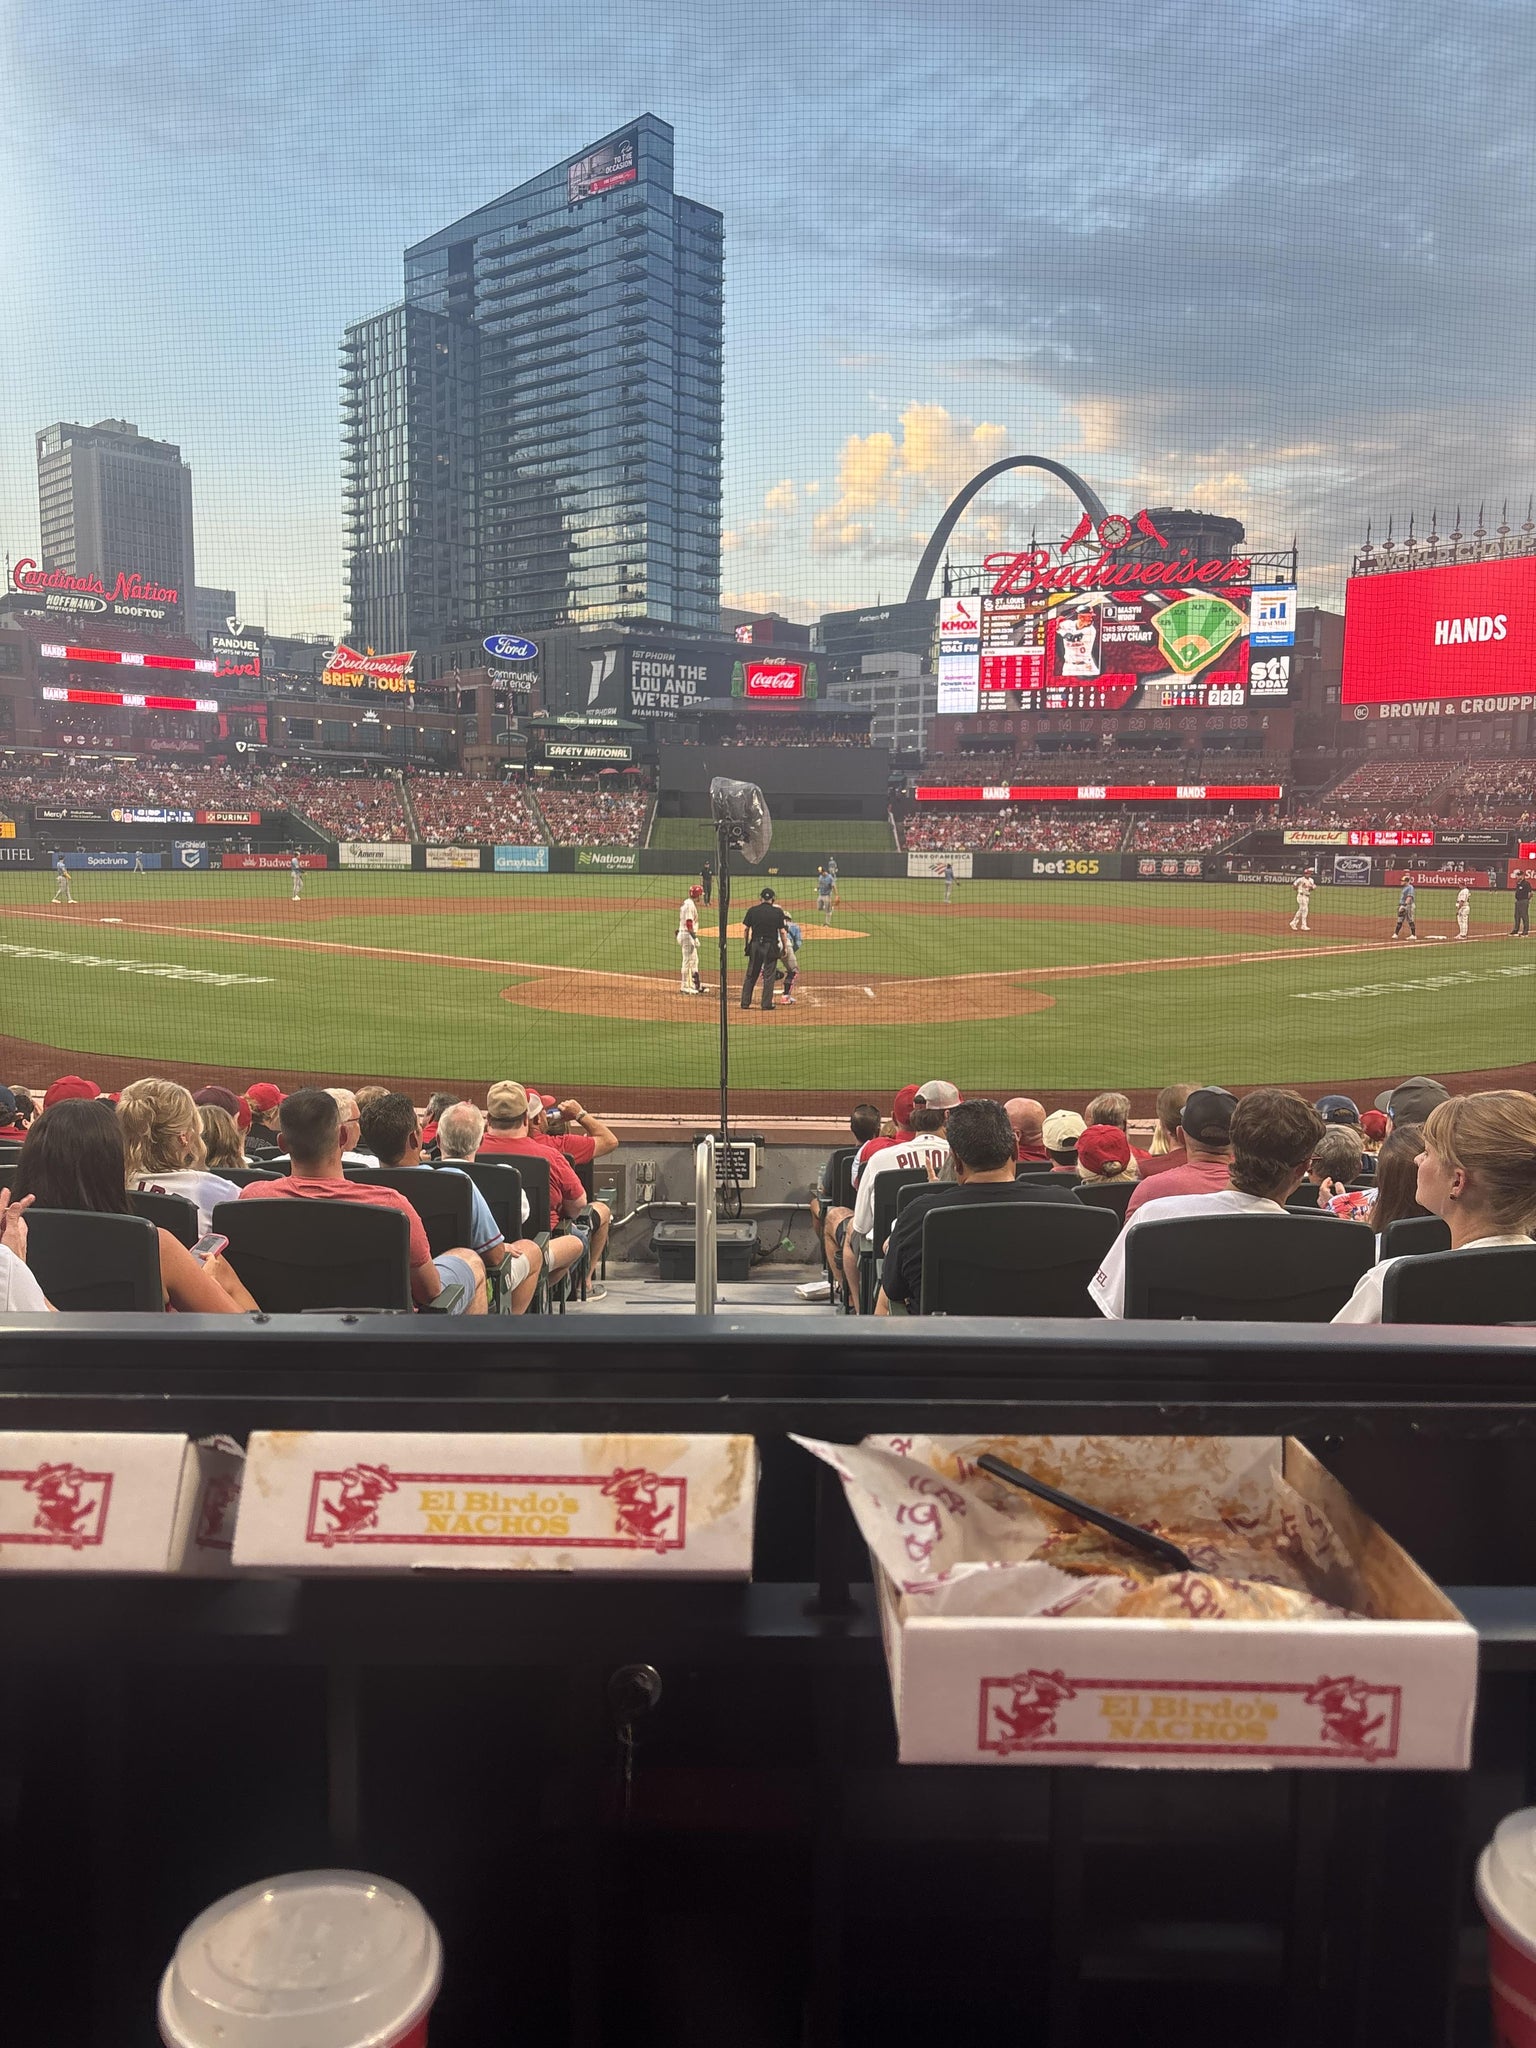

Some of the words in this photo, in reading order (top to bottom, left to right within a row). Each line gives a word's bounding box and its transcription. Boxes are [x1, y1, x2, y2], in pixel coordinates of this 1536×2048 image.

[614, 155, 621, 164] TO
[622, 152, 633, 161] THE
[605, 159, 633, 174] OCCASION
[1375, 549, 1450, 570] WORLD
[983, 549, 1250, 595] Budweiser
[13, 557, 105, 594] Cardinals
[105, 571, 178, 604] Nation
[46, 594, 97, 610] HOFFMANN
[114, 604, 166, 619] ROOFTOP
[941, 620, 978, 631] KMOX
[1117, 625, 1140, 633] SEASON
[1435, 614, 1508, 645] HANDS
[212, 637, 260, 651] FANDUEL
[1102, 633, 1130, 643] SPRAY
[1130, 631, 1153, 642] CHART
[41, 643, 67, 658] HANDS
[213, 647, 234, 656] SPORTS
[495, 637, 528, 656] Ford
[964, 643, 978, 652] FM
[121, 652, 145, 666] HANDS
[322, 651, 414, 674] Budweiser
[632, 650, 646, 659] 1ST
[645, 652, 676, 661] PHORM
[195, 659, 217, 673] HANDS
[214, 656, 261, 678] Live!
[631, 660, 675, 678] FROM
[678, 664, 707, 681] THE
[1251, 656, 1290, 680] stl
[322, 671, 365, 688] BREW
[368, 676, 416, 693] HOUSE
[488, 667, 538, 684] Community
[750, 672, 798, 689] Coca-Cola
[632, 676, 661, 692] LOU
[664, 678, 696, 695] AND
[1251, 680, 1289, 689] TODAY
[42, 686, 68, 700] HANDS
[631, 691, 680, 709] WE'RE
[122, 694, 146, 707] HANDS
[1379, 701, 1440, 719] BROWN
[1444, 703, 1456, 715] &
[1037, 719, 1050, 733] 10
[1058, 719, 1072, 732] 14
[1079, 718, 1094, 732] 17
[1128, 717, 1146, 731] 23
[1153, 717, 1171, 731] 24
[1179, 716, 1198, 730] 42
[1205, 716, 1224, 730] 45
[549, 746, 583, 757] SAFETY
[583, 747, 628, 759] NATIONAL
[982, 787, 1010, 800] HANDS
[1077, 786, 1107, 799] HANDS
[1176, 786, 1207, 799] HANDS
[43, 809, 63, 819] Mercy
[216, 813, 249, 821] PURINA
[1288, 830, 1343, 840] Schnucks
[1441, 835, 1460, 844] Mercy
[174, 841, 206, 849] CarShield
[87, 856, 125, 866] Spectrum
[357, 850, 385, 858] Ameren
[592, 853, 635, 864] National
[496, 857, 545, 868] Graybar
[1032, 858, 1100, 875] bet365
[1142, 865, 1153, 873] 66
[1163, 865, 1176, 873] 66
[1186, 865, 1198, 873] 66
[1341, 859, 1364, 871] Ford
[1237, 874, 1262, 883] BUSCH
[1263, 874, 1296, 883] STADIUM
[1417, 873, 1475, 885] Budweiser
[419, 1490, 455, 1513] El
[463, 1491, 579, 1515] Birdo's
[424, 1513, 571, 1536] NACHOS
[1099, 1695, 1140, 1717] El
[1152, 1696, 1278, 1721] Birdo's
[1109, 1719, 1269, 1742] NACHOS
